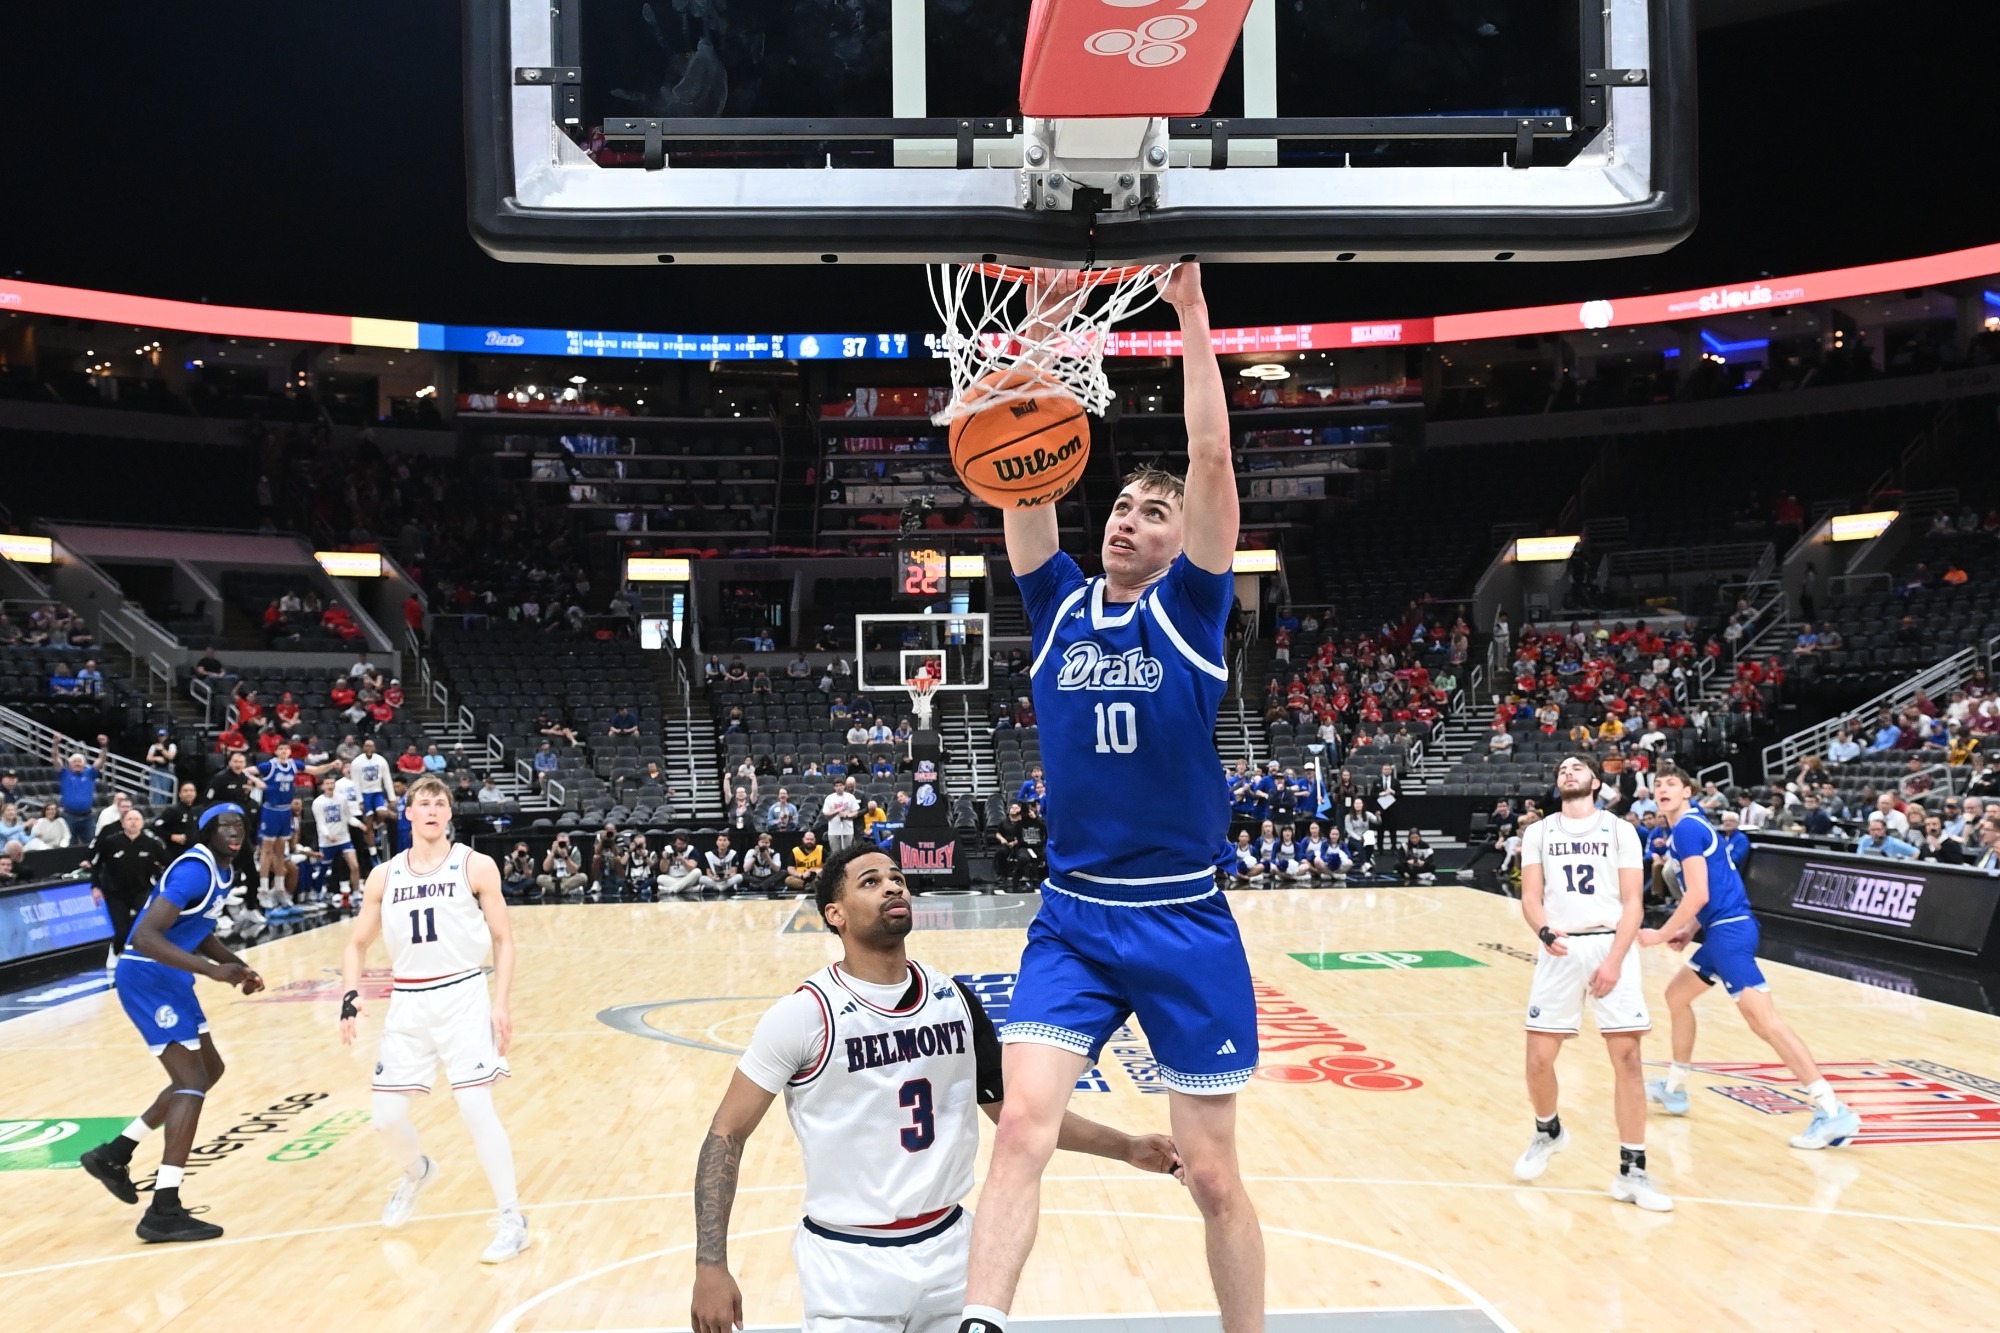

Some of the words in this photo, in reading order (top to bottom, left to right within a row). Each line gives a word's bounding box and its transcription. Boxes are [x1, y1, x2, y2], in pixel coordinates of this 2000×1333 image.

[843, 338, 867, 357] 37
[992, 435, 1083, 482] Wilson
[1016, 478, 1075, 508] NCAA
[905, 566, 938, 594] 22
[1057, 640, 1164, 693] Drake
[1094, 702, 1138, 754] 10
[900, 840, 956, 869] VALLEY
[1548, 841, 1609, 857] BELMONT
[392, 882, 457, 905] BELMONT
[1562, 864, 1595, 895] 12
[1850, 876, 1924, 921] HERE
[409, 907, 438, 944] 11
[845, 1020, 967, 1073] BELMONT
[1110, 1046, 1169, 1094] MISSOURI
[899, 1077, 935, 1153] 3
